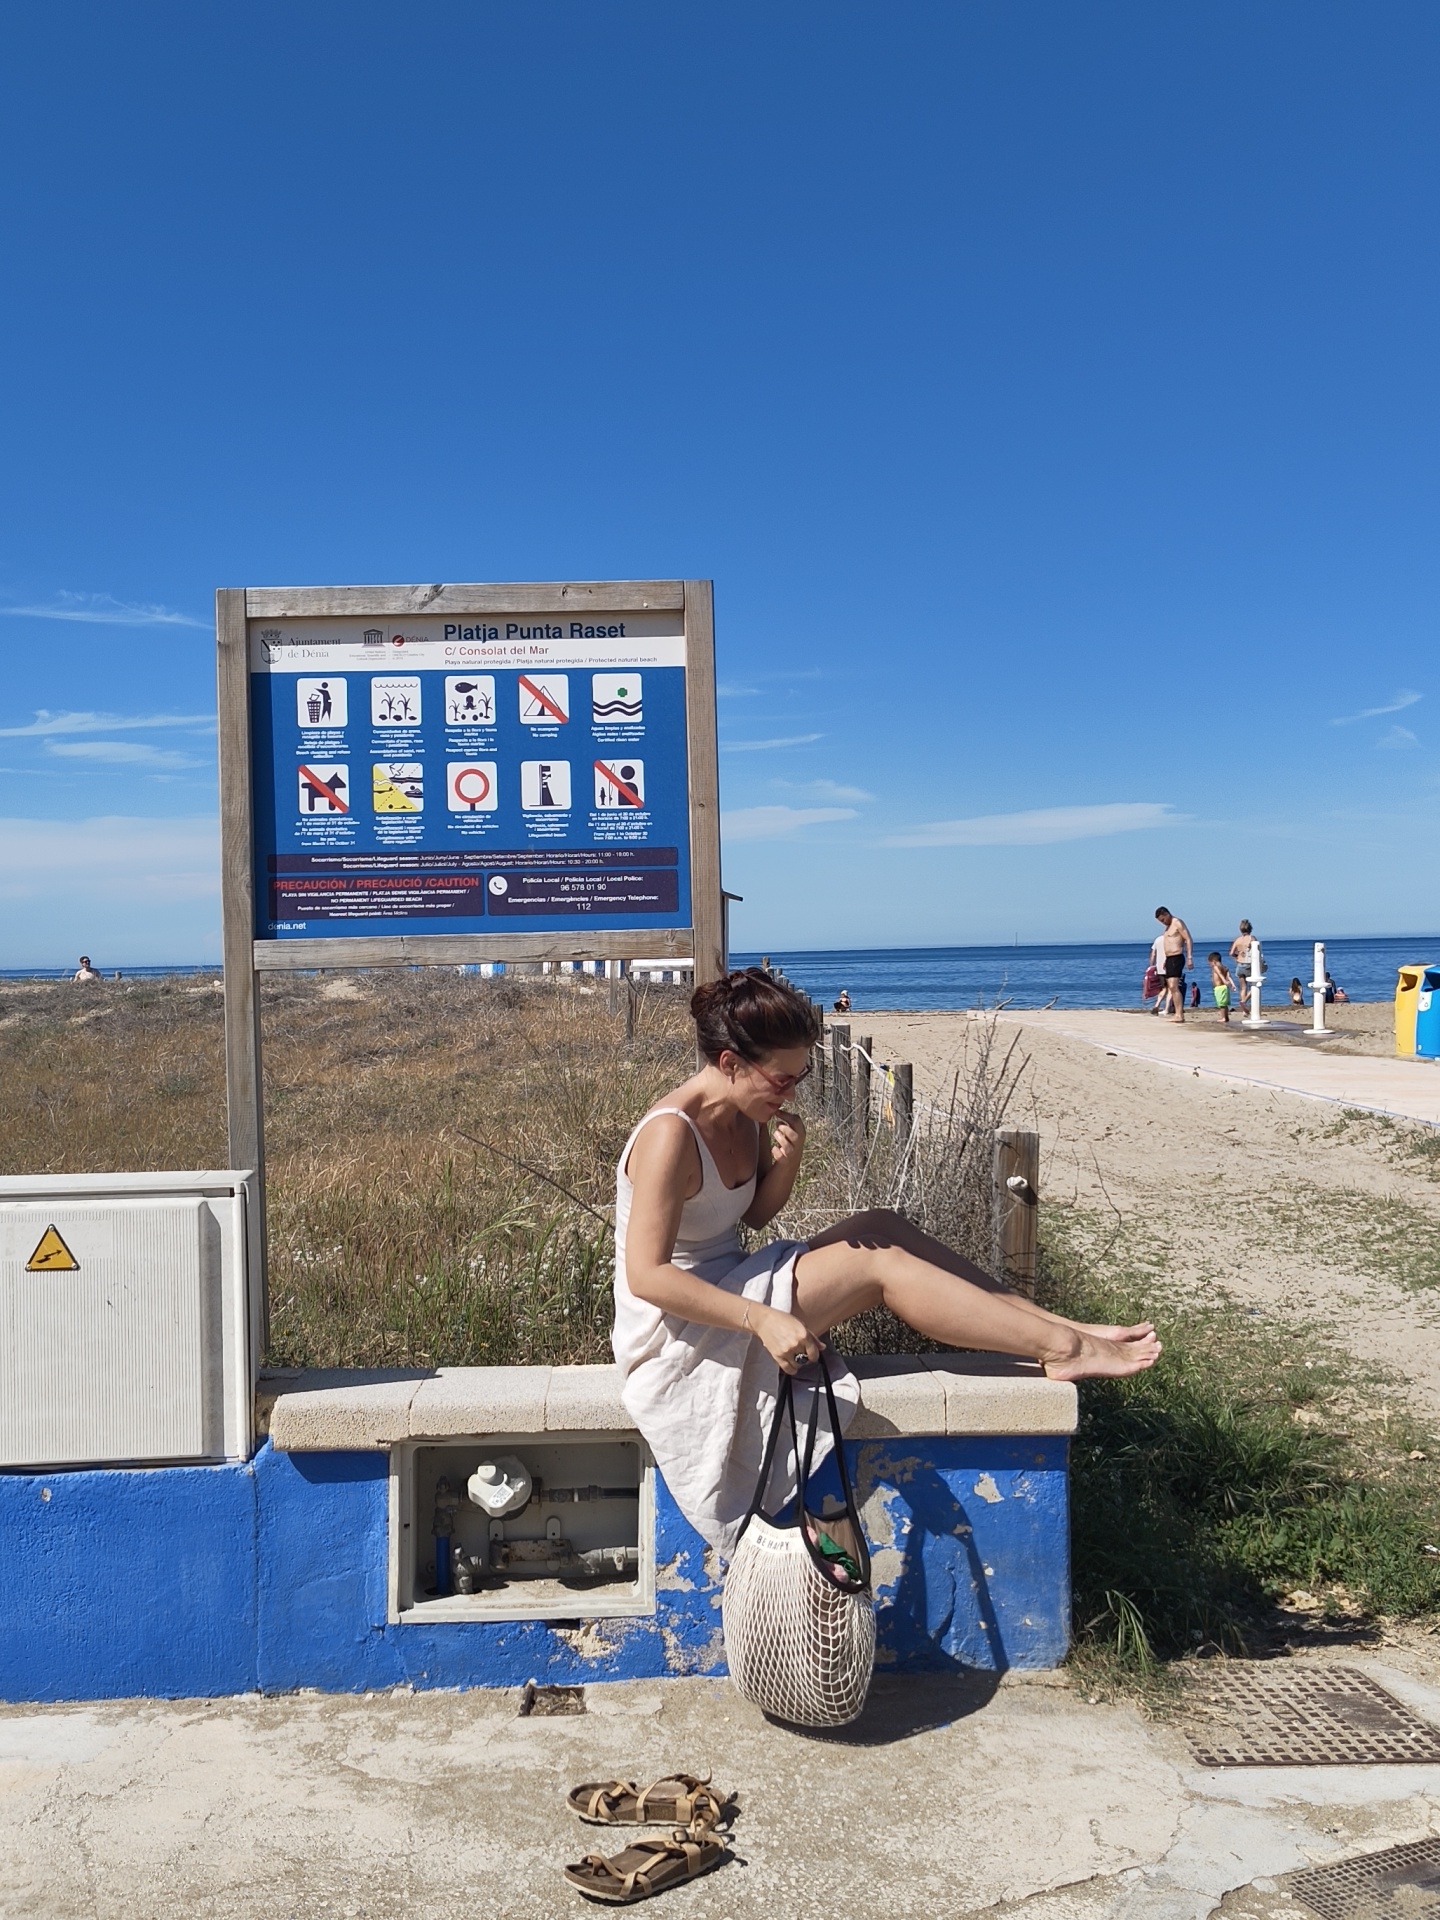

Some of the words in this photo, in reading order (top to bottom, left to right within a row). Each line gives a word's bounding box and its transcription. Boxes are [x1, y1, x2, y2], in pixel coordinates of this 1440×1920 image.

[444, 624, 499, 643] Platja
[506, 623, 562, 640] Punta
[570, 623, 626, 639] Raset
[288, 637, 341, 646] Ajuntament
[288, 649, 299, 658] de
[302, 649, 329, 658] Dénia
[445, 647, 457, 656] C/
[459, 646, 507, 656] Consolat
[510, 646, 527, 655] del
[530, 646, 549, 655] Mar
[273, 878, 346, 890] PRECAUCIÓN
[356, 877, 422, 889] PRECAUCIÓ
[268, 922, 306, 930] denia.net
[756, 1535, 767, 1546] BE
